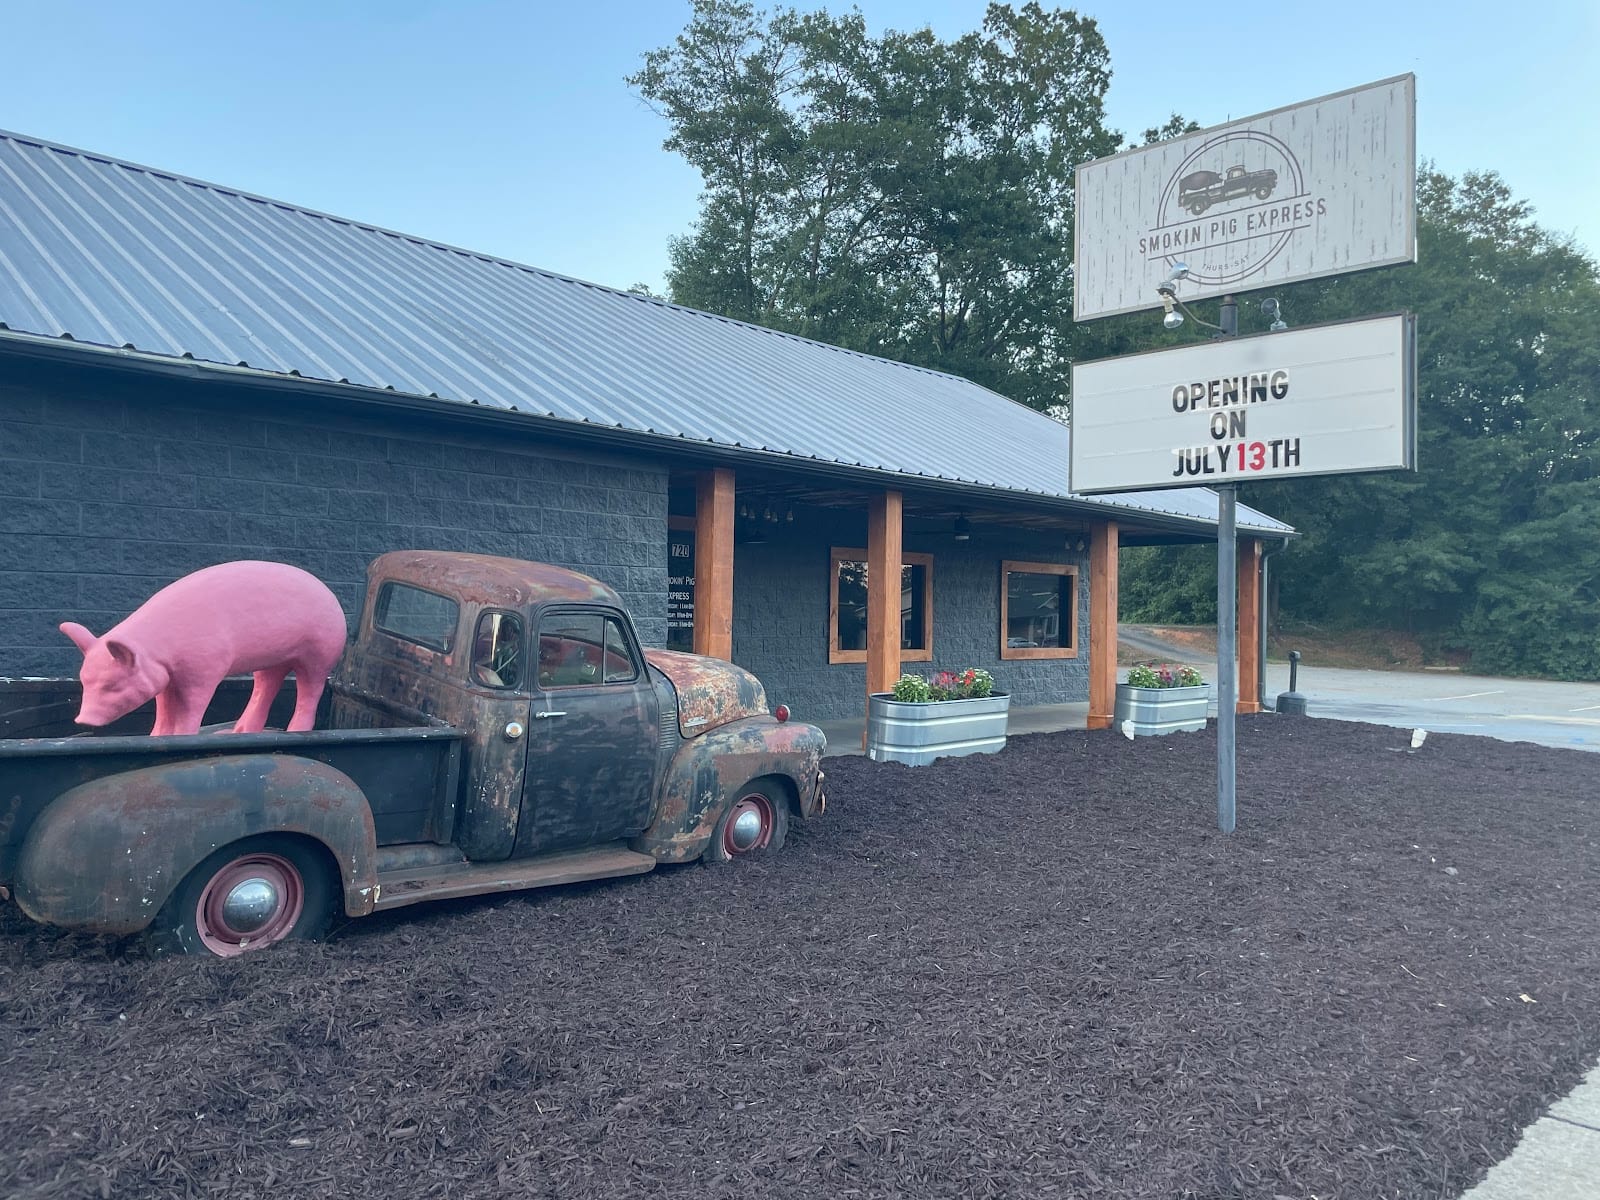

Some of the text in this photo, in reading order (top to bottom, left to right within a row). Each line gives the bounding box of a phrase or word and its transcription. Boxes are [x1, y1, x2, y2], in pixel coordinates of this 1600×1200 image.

[1139, 198, 1326, 254] SMOKIN PIG EXPRESS
[1172, 370, 1289, 413] OPENING
[1210, 410, 1246, 440] ON
[1173, 438, 1300, 477] JULY 13TH
[672, 544, 689, 557] 720
